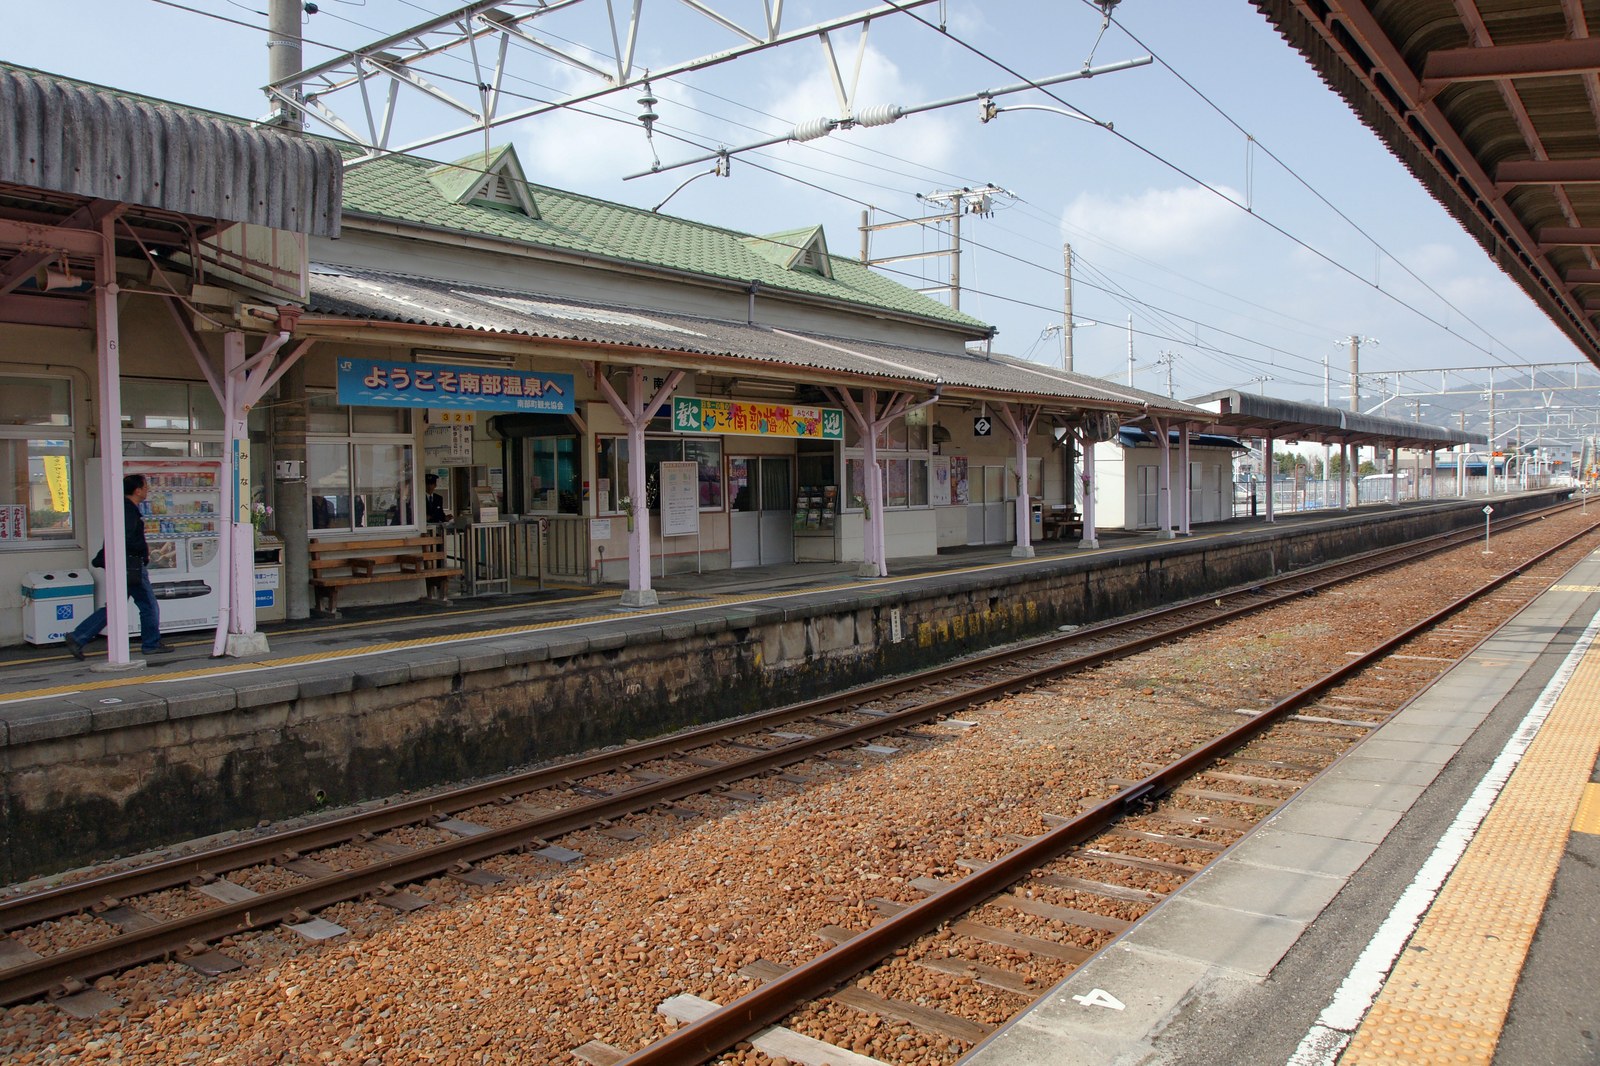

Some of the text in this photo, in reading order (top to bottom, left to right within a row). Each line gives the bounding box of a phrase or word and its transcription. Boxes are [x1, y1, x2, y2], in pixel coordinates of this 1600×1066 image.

[110, 340, 116, 350] 6
[341, 361, 352, 369] JR
[364, 366, 564, 397] ようこそ南部温泉へ
[443, 413, 449, 421] 3
[455, 414, 461, 422] 2
[676, 402, 700, 429] 歓
[238, 422, 244, 431] 7
[824, 412, 841, 435] 迎
[979, 421, 986, 431] 2
[286, 462, 292, 472] 7
[240, 452, 248, 510] みなべ
[1071, 988, 1126, 1011] 4
